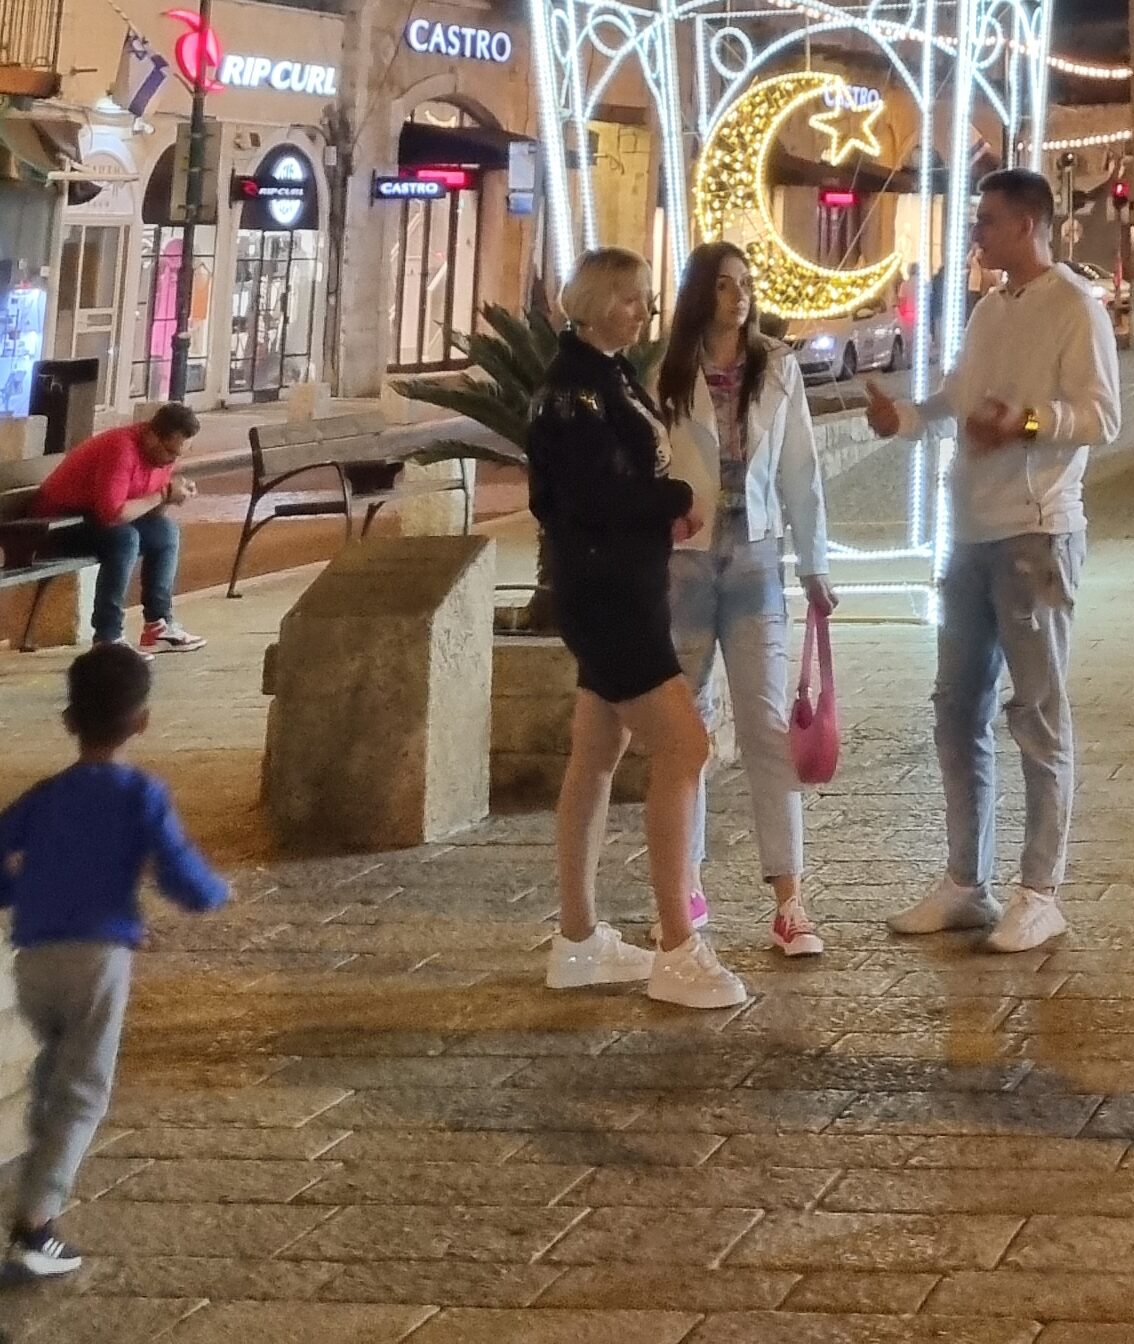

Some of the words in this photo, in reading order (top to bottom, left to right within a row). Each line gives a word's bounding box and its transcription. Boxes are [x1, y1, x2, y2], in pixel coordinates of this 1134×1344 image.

[408, 18, 512, 63] CASTRO
[220, 54, 272, 87] RIP
[271, 60, 337, 96] CURL
[380, 182, 438, 195] CASTRO
